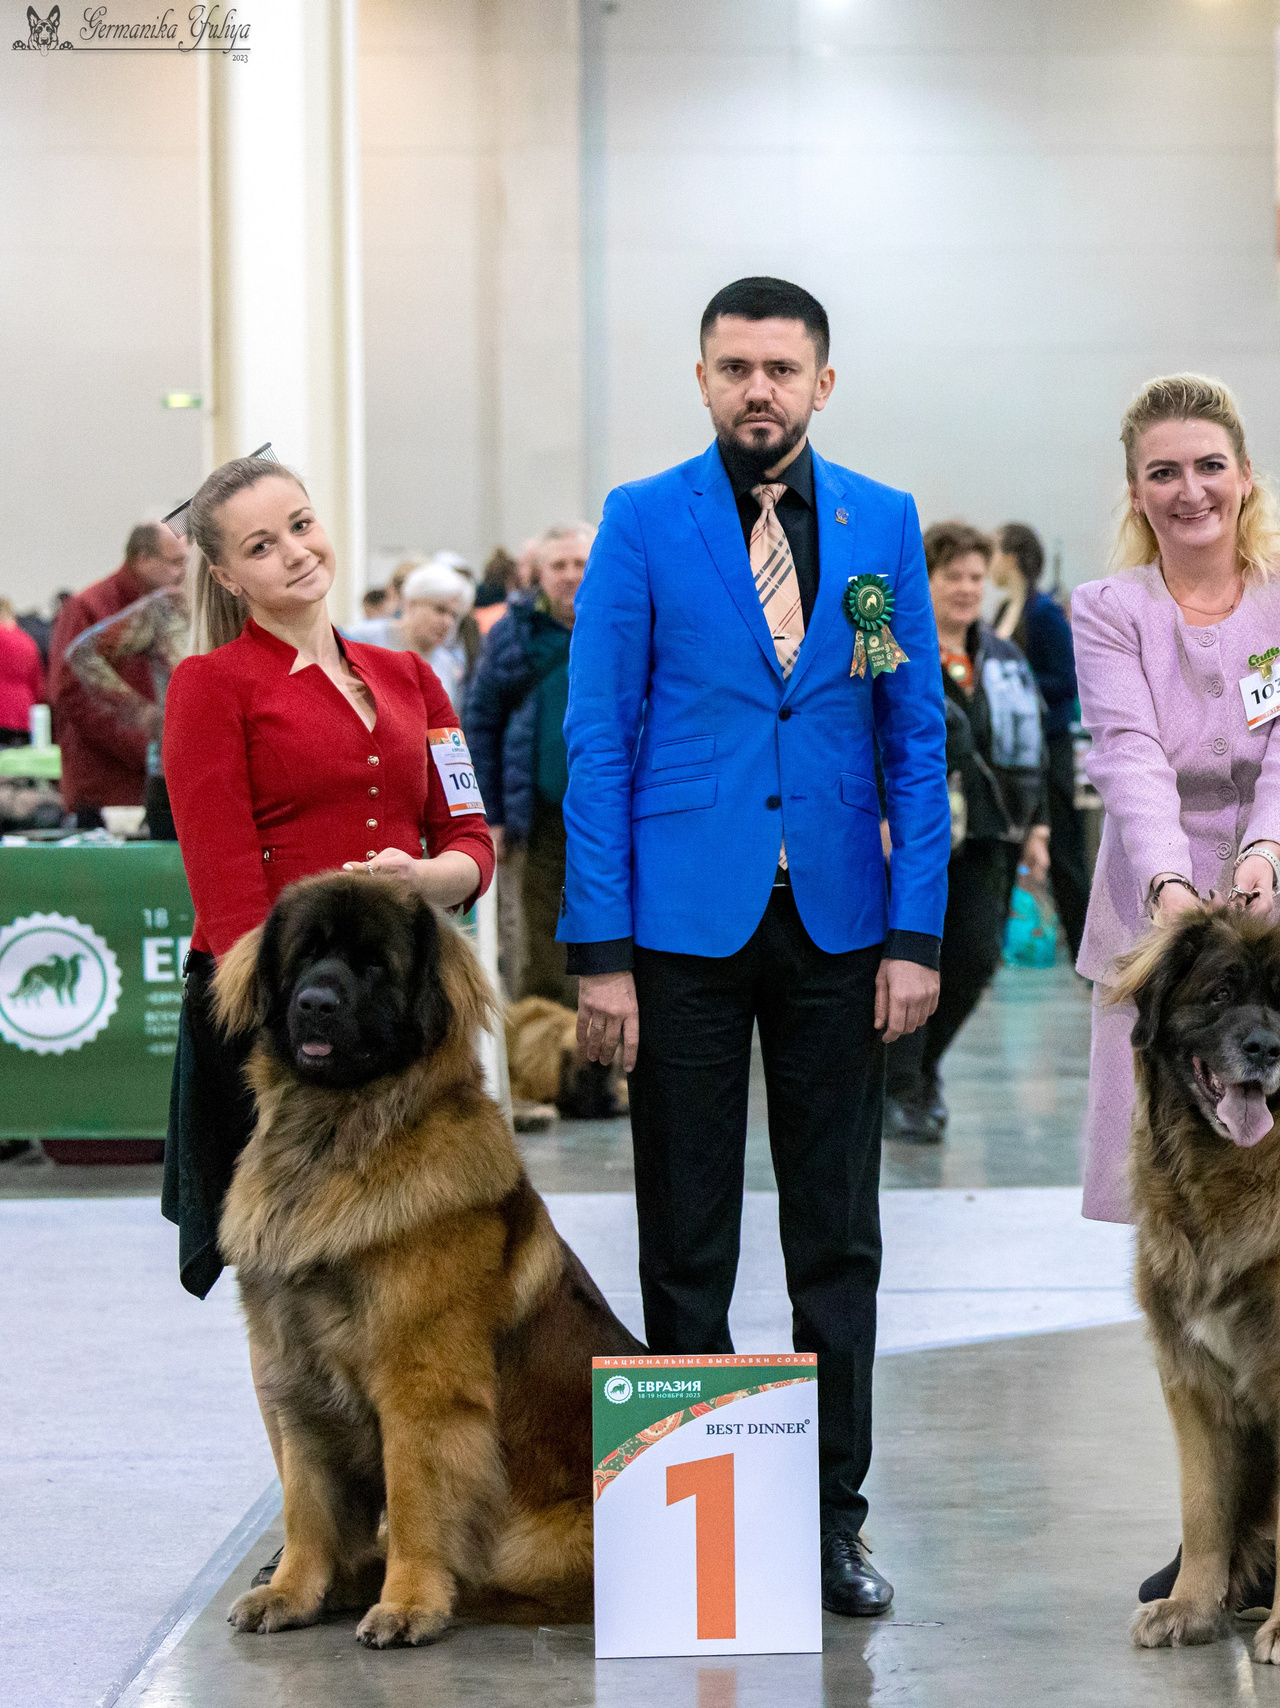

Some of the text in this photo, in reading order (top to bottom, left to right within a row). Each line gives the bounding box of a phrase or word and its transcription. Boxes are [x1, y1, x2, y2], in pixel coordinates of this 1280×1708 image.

[1248, 647, 1280, 667] Crufts
[143, 907, 169, 928] 18
[604, 1358, 701, 1366] НАЦИОНАЛЬНЫЕ
[637, 1380, 701, 1393] ЕВРАЗИЯ
[705, 1423, 744, 1435] BEST
[666, 1453, 736, 1640] 1
